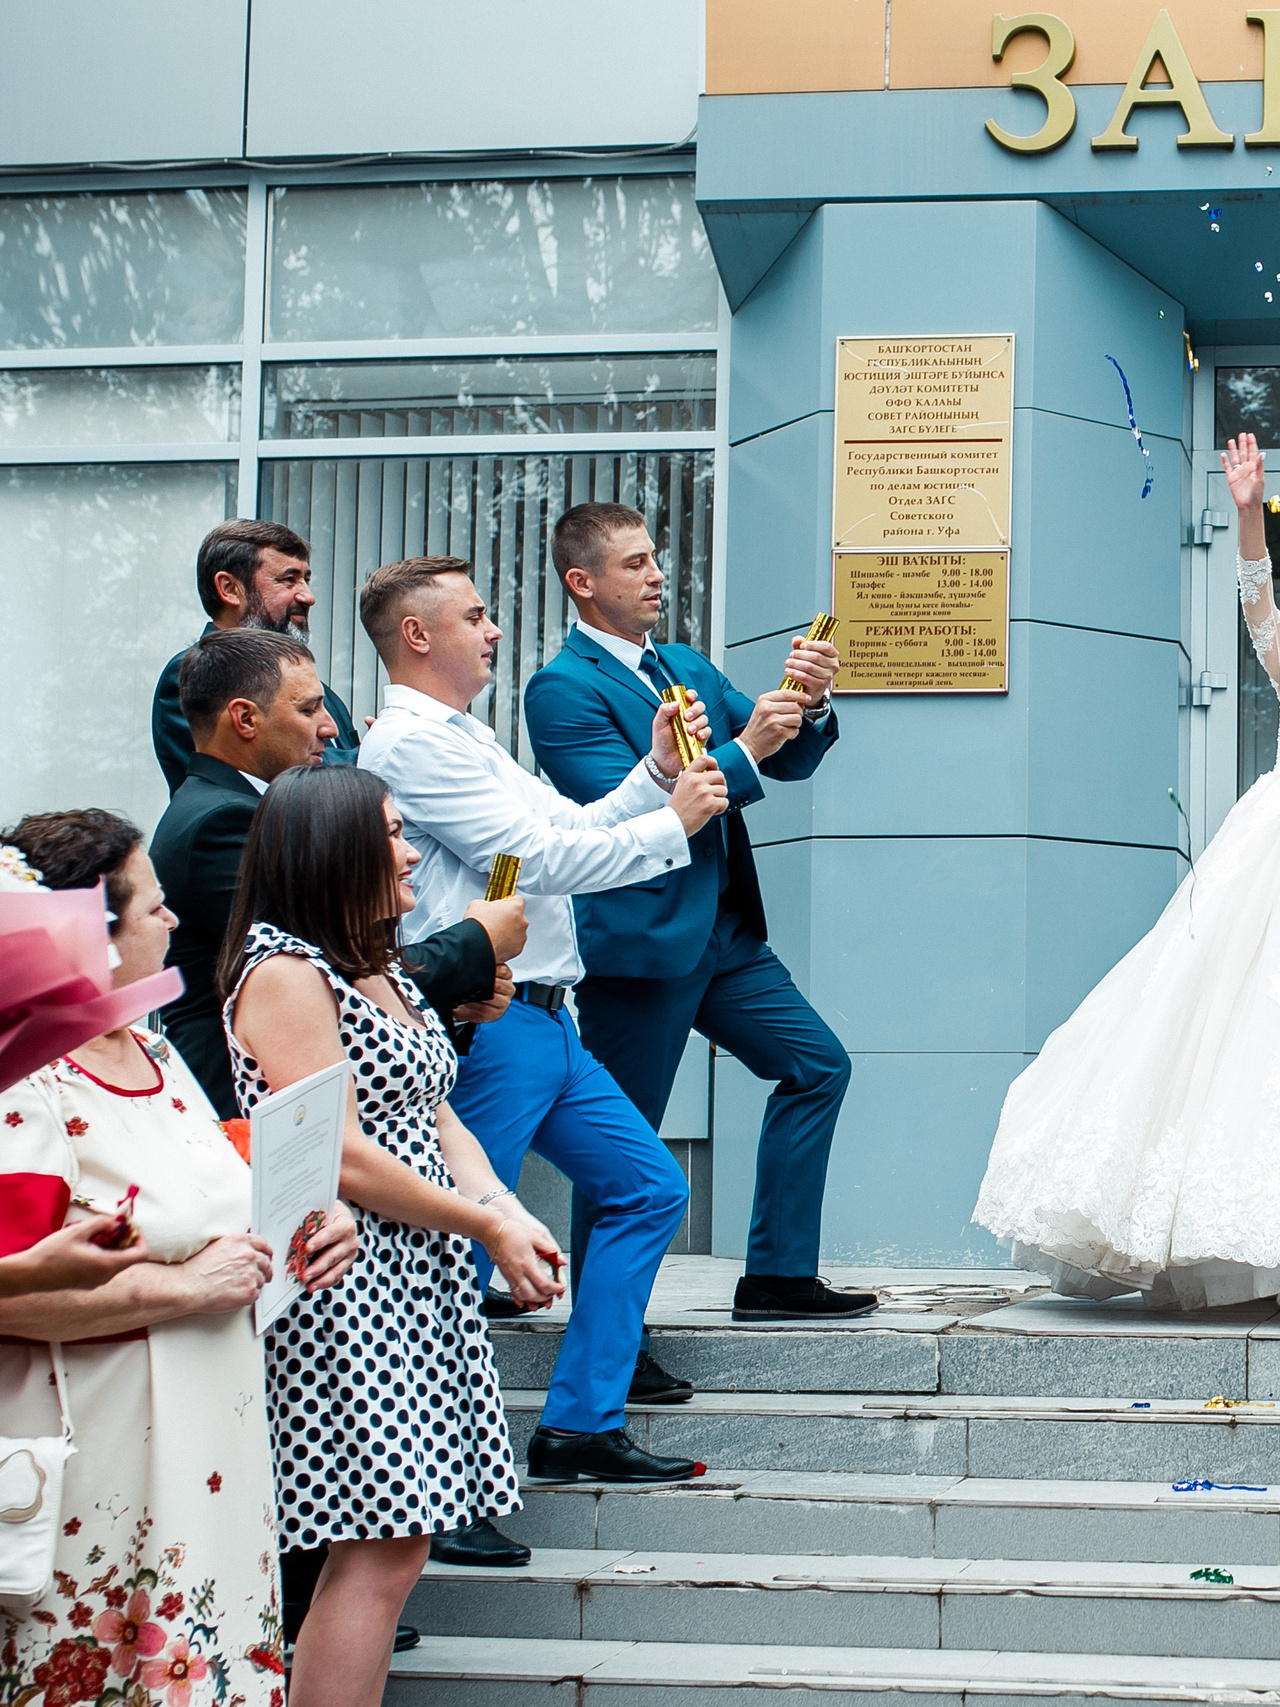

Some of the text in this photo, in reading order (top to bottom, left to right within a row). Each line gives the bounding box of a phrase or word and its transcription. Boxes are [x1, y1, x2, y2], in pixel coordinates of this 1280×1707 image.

[844, 372, 900, 381] ЮСТИЦИЯ
[952, 369, 1004, 379] БУЙЫНСА
[917, 384, 978, 393] КОМИТЕТЫ
[868, 412, 902, 420] СОВЕТ
[889, 425, 915, 434] ЗАГС
[848, 451, 947, 463] Государственный
[847, 465, 999, 477] Республики Башкортостан
[887, 483, 920, 491] делам
[889, 496, 956, 505] Отдел ЗАГС
[890, 512, 953, 520] Советского
[883, 527, 923, 537] района
[937, 526, 960, 537] Уфа
[877, 556, 898, 565] ЭШ
[866, 626, 976, 635] РЕЖИМ РАБОТЫ:
[850, 640, 887, 648] Вторник
[895, 640, 927, 648] суббота
[945, 638, 963, 646] 9.00
[973, 638, 996, 646] 18.00
[850, 651, 888, 659] Перерыв
[941, 649, 964, 657] 13.00
[886, 679, 933, 687] санитарный
